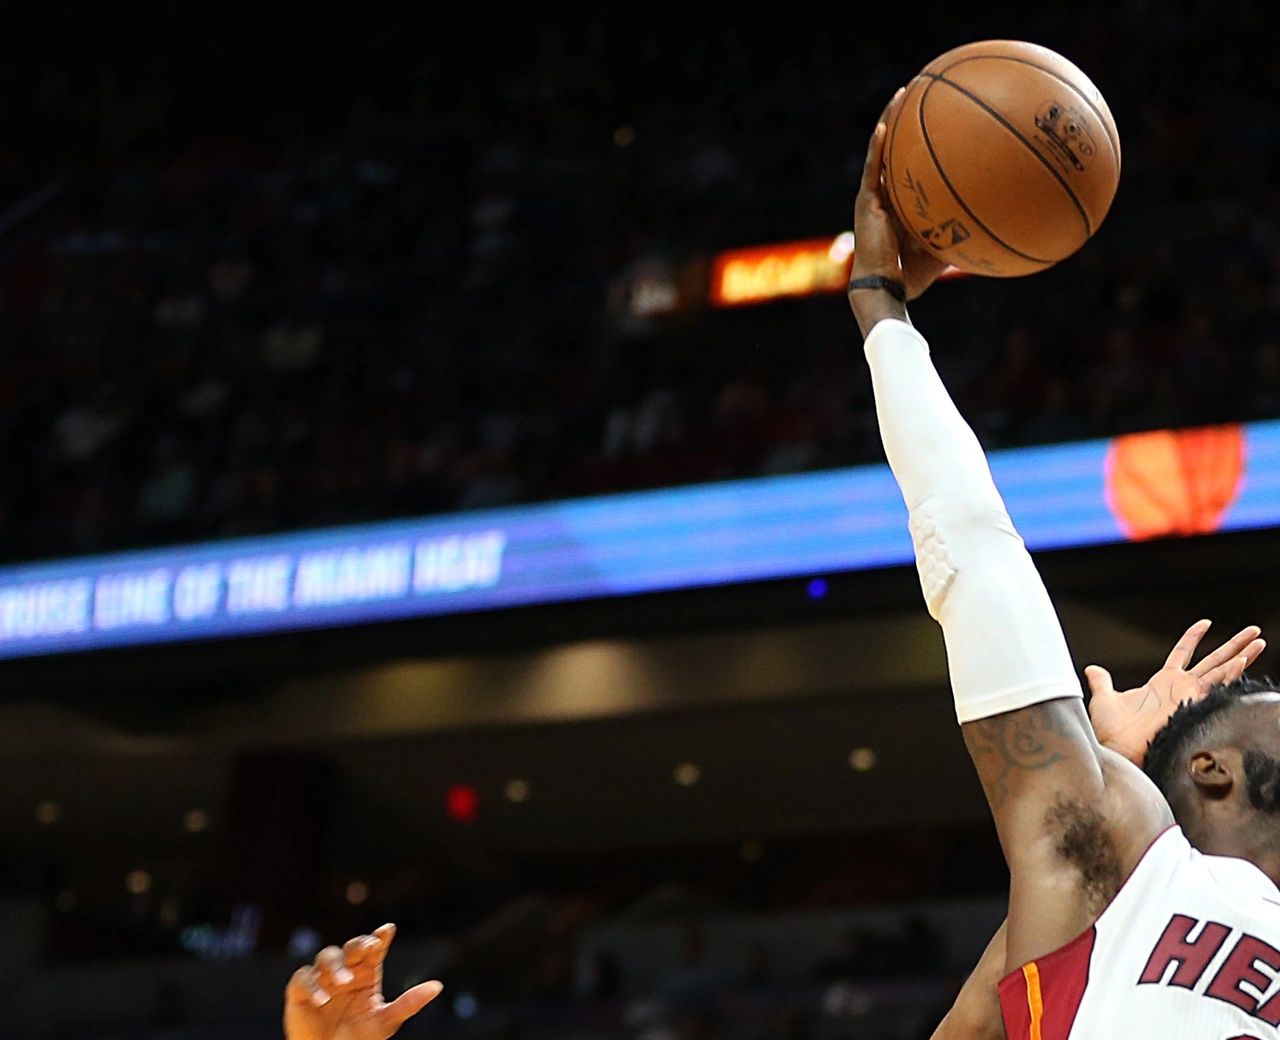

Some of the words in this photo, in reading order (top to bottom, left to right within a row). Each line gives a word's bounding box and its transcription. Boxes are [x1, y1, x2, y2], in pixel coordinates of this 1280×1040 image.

[173, 560, 222, 620] OF
[226, 552, 293, 613] THE
[293, 540, 411, 606] MIAMI
[412, 529, 506, 593] HEAT
